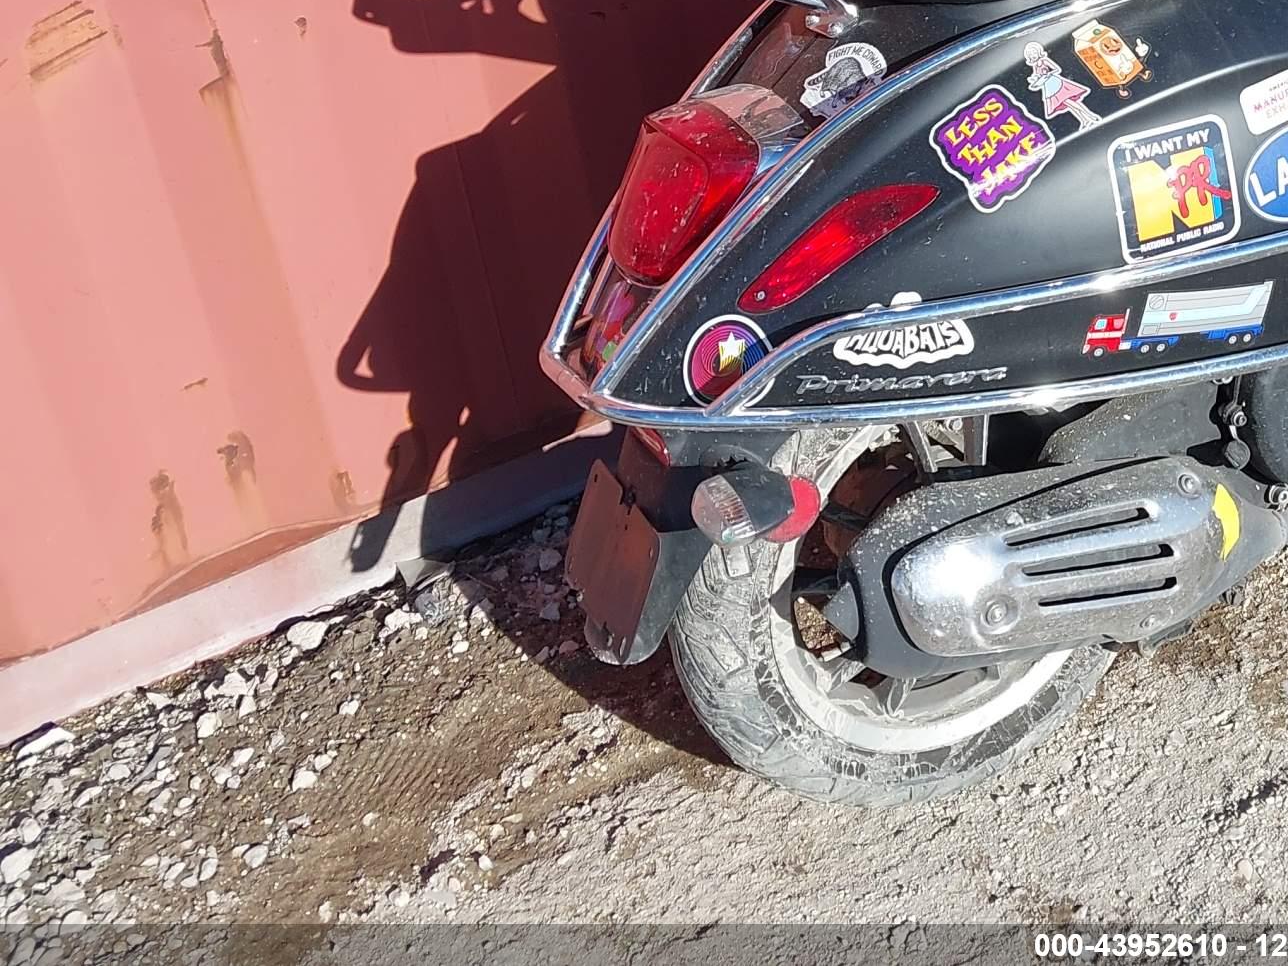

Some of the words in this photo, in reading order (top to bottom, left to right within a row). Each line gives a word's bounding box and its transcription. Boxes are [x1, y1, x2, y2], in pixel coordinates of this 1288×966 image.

[828, 46, 852, 62] FIGHT
[852, 45, 865, 56] ME
[862, 48, 884, 76] COWARD
[944, 97, 1003, 147] LESS
[957, 115, 1023, 166] THAN
[1124, 149, 1132, 163] I
[1133, 136, 1184, 160] WANT
[1186, 128, 1211, 147] MY
[980, 132, 1042, 196] JAKE
[1139, 237, 1175, 253] NATIONAL
[1176, 229, 1202, 243] PUBLIC
[1203, 221, 1225, 235] RADIO
[796, 367, 1008, 394] Primavera
